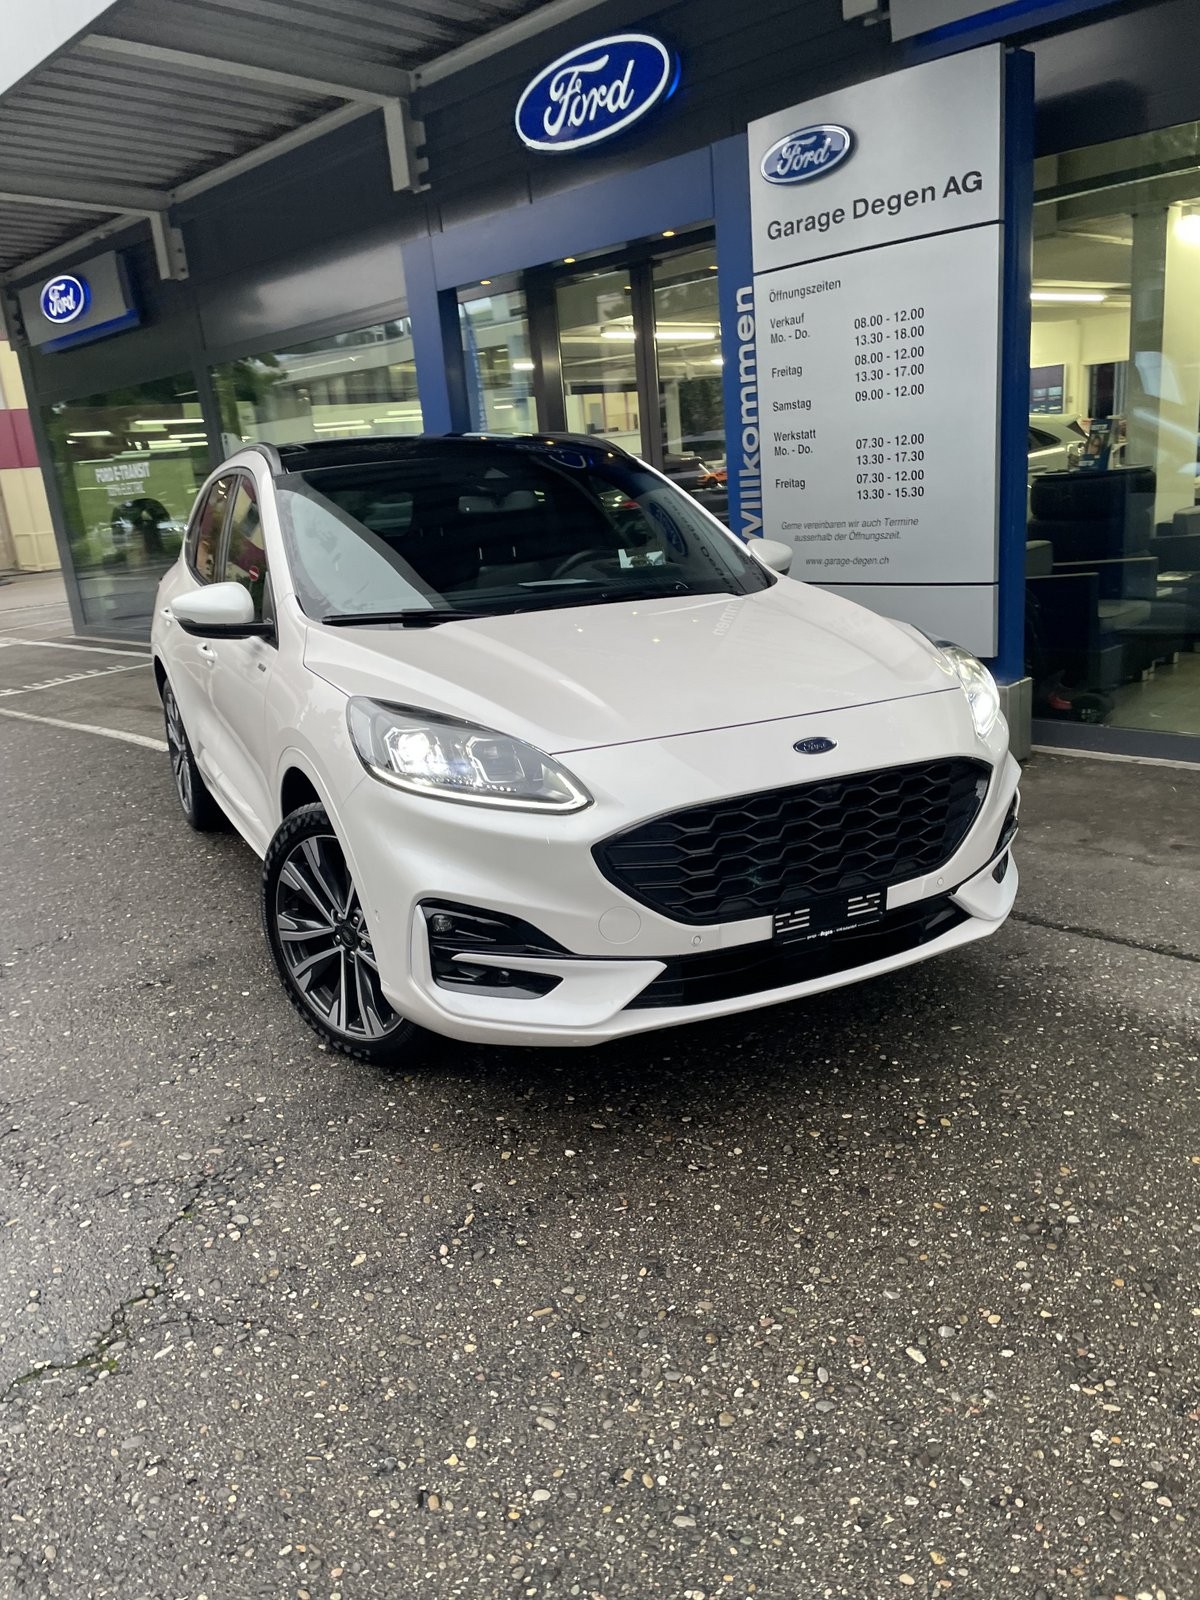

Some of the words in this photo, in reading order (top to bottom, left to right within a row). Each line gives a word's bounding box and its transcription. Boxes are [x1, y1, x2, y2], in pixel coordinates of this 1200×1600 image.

[543, 54, 635, 136] Ford
[776, 135, 832, 176] Ford
[767, 207, 845, 240] Garage
[852, 185, 936, 219] Degen
[943, 170, 983, 198] AG
[769, 279, 841, 303] Öffnungszeiten
[48, 283, 76, 317] Ford
[770, 313, 804, 328] Verkauf
[854, 314, 883, 329] 08.00
[894, 307, 924, 322] 12.00
[770, 333, 786, 344] Mo.
[795, 329, 810, 339] Do.
[855, 332, 883, 346] 13.30
[894, 325, 924, 340] 18.00
[855, 352, 883, 366] 08.00
[894, 346, 924, 360] 12.00
[771, 366, 803, 378] Freitag
[855, 369, 883, 382] 13.30
[894, 363, 924, 377] 17.00
[855, 388, 884, 402] 09.00
[894, 383, 924, 397] 12.00
[772, 399, 812, 412] Samstag
[773, 429, 816, 442] Werkstatt
[856, 437, 884, 449] 07.30
[895, 433, 924, 446] 12.00
[774, 446, 789, 456] Mo.
[797, 444, 813, 454] Do.
[856, 453, 884, 465] 13.30
[895, 450, 924, 462] 17.30
[775, 478, 806, 490] Freitag
[856, 472, 884, 484] 07.30
[895, 469, 924, 481] 12.00
[857, 488, 884, 500] 13.30
[895, 486, 924, 498] 15.30
[803, 519, 847, 529] vereinbaren
[848, 519, 860, 528] wir
[861, 518, 882, 528] auch
[884, 517, 919, 527] Termine
[794, 532, 833, 542] ausserhalb
[834, 532, 847, 541] der
[805, 556, 890, 567] www.garage-degen.ch
